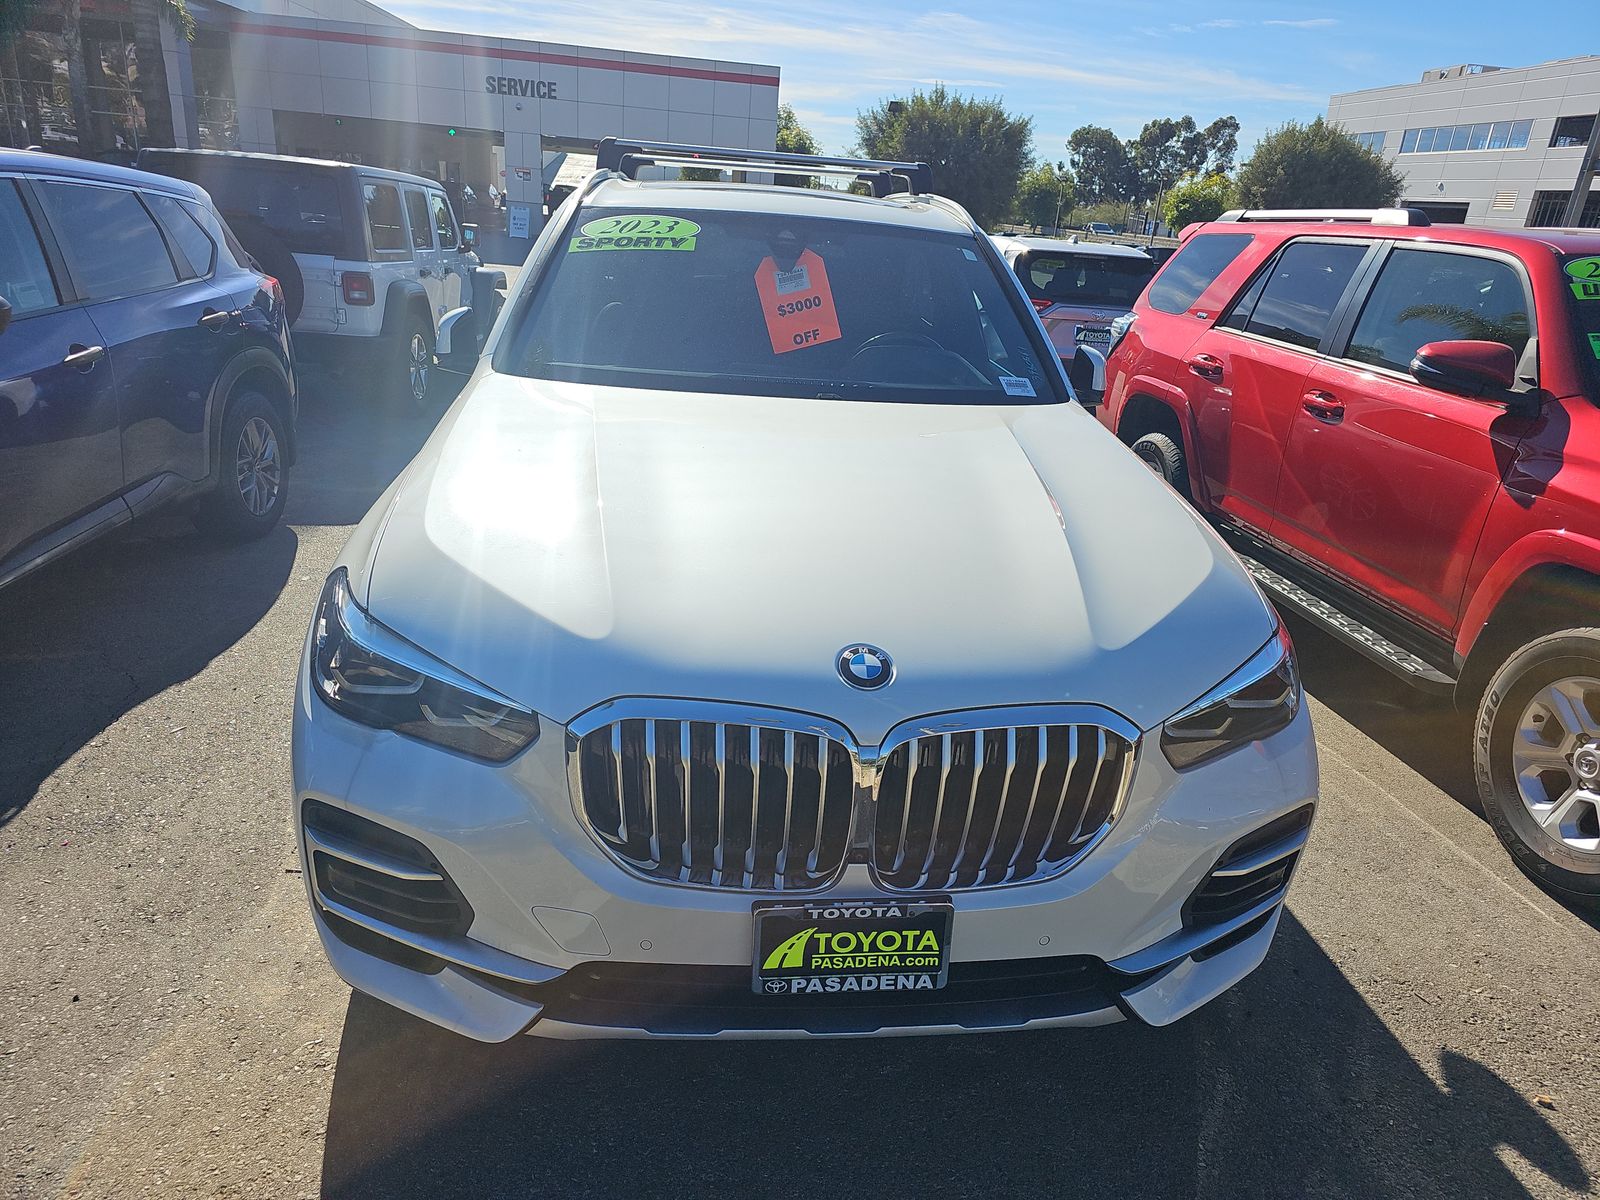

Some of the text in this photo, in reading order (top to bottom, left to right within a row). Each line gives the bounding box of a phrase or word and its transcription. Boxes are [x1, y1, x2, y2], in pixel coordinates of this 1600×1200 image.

[485, 75, 558, 100] SERVICE
[597, 219, 680, 234] 2023
[576, 236, 690, 249] SPORTY
[777, 295, 822, 318] $3000
[792, 328, 820, 345] OFF
[1086, 331, 1110, 339] TOYOTA
[843, 647, 886, 660] BMW
[808, 906, 903, 919] TOYOTA
[813, 929, 940, 954] TOYOTA
[811, 955, 939, 969] PASADENA.com
[791, 975, 934, 993] PASADENA
